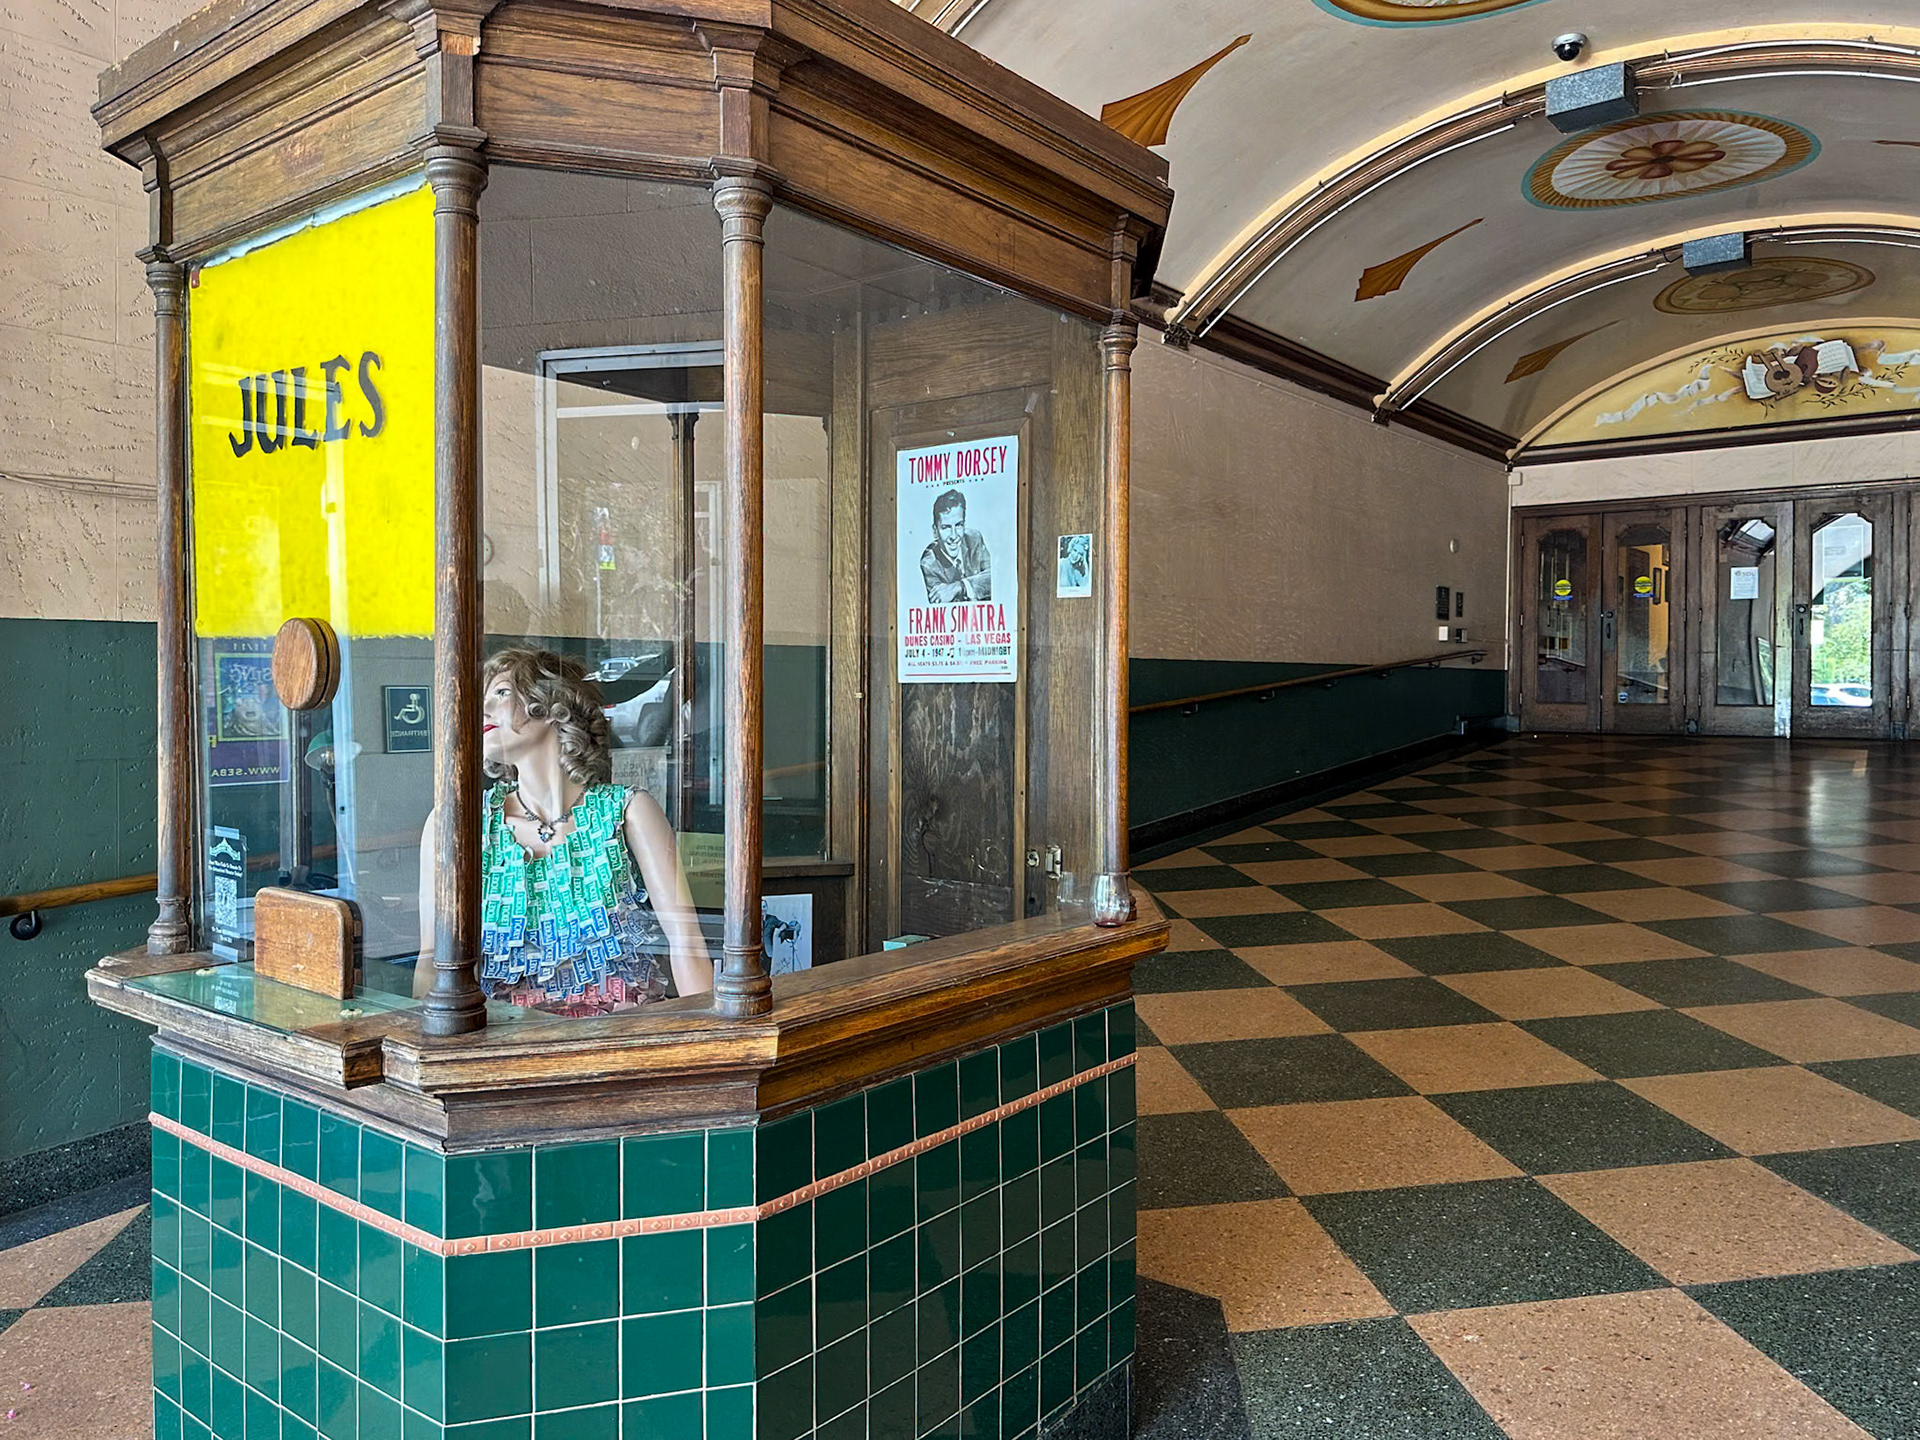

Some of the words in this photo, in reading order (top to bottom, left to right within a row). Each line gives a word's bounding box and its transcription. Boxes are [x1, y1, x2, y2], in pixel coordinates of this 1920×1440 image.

[229, 350, 384, 458] JULES
[909, 452, 950, 484] TOMMY
[957, 445, 1007, 478] DORSEY
[909, 606, 946, 634] FRANK
[951, 603, 1005, 633] SINATRA
[905, 635, 927, 646] DUNES
[930, 634, 954, 646] CASINO
[965, 633, 981, 645] LAS
[984, 632, 1011, 644] VEGAS
[905, 649, 920, 658] JULY
[921, 648, 925, 657] 4
[932, 647, 944, 657] 1947
[610, 848, 618, 868] TICKET
[573, 878, 582, 898] TICKET
[513, 919, 522, 939] TICKET
[595, 909, 605, 930] TICKET
[484, 931, 493, 952] TICKET
[544, 921, 554, 942] TICKET
[606, 938, 617, 957] TICKET
[577, 960, 589, 981] TICKET
